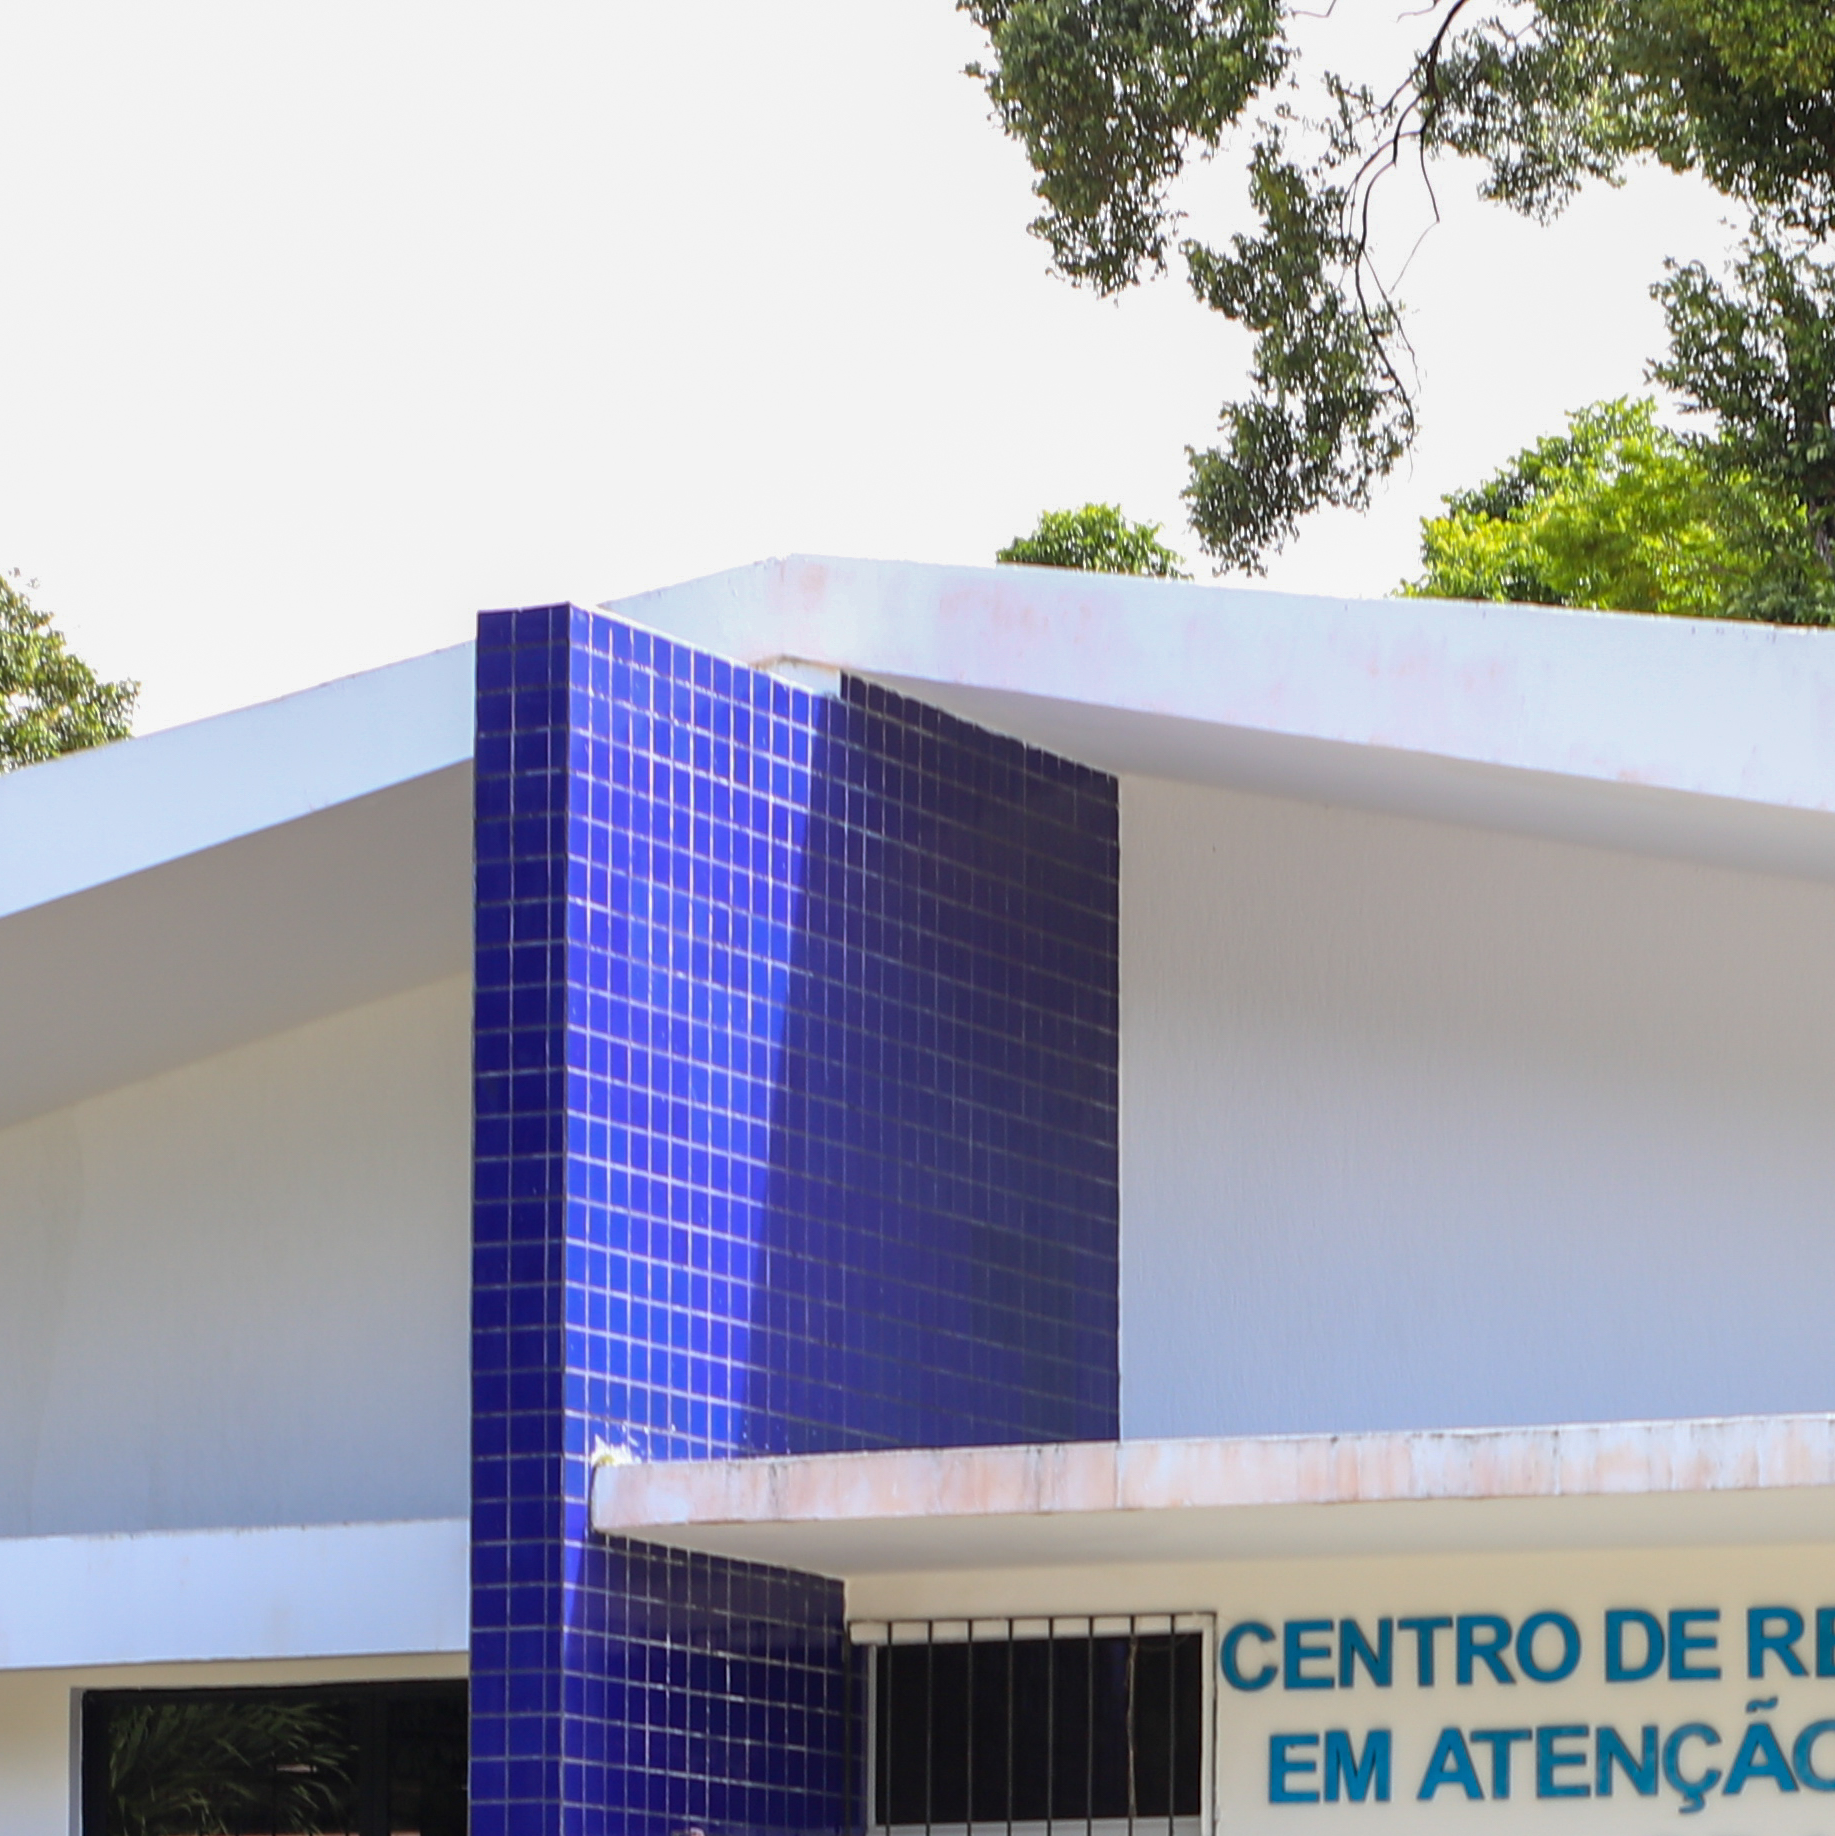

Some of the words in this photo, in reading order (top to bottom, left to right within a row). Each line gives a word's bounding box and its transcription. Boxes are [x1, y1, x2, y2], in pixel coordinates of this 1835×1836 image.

[1220, 1610, 1582, 1692] CENTRO
[1604, 1608, 1722, 1684] DE
[1268, 1727, 1392, 1805] EM
